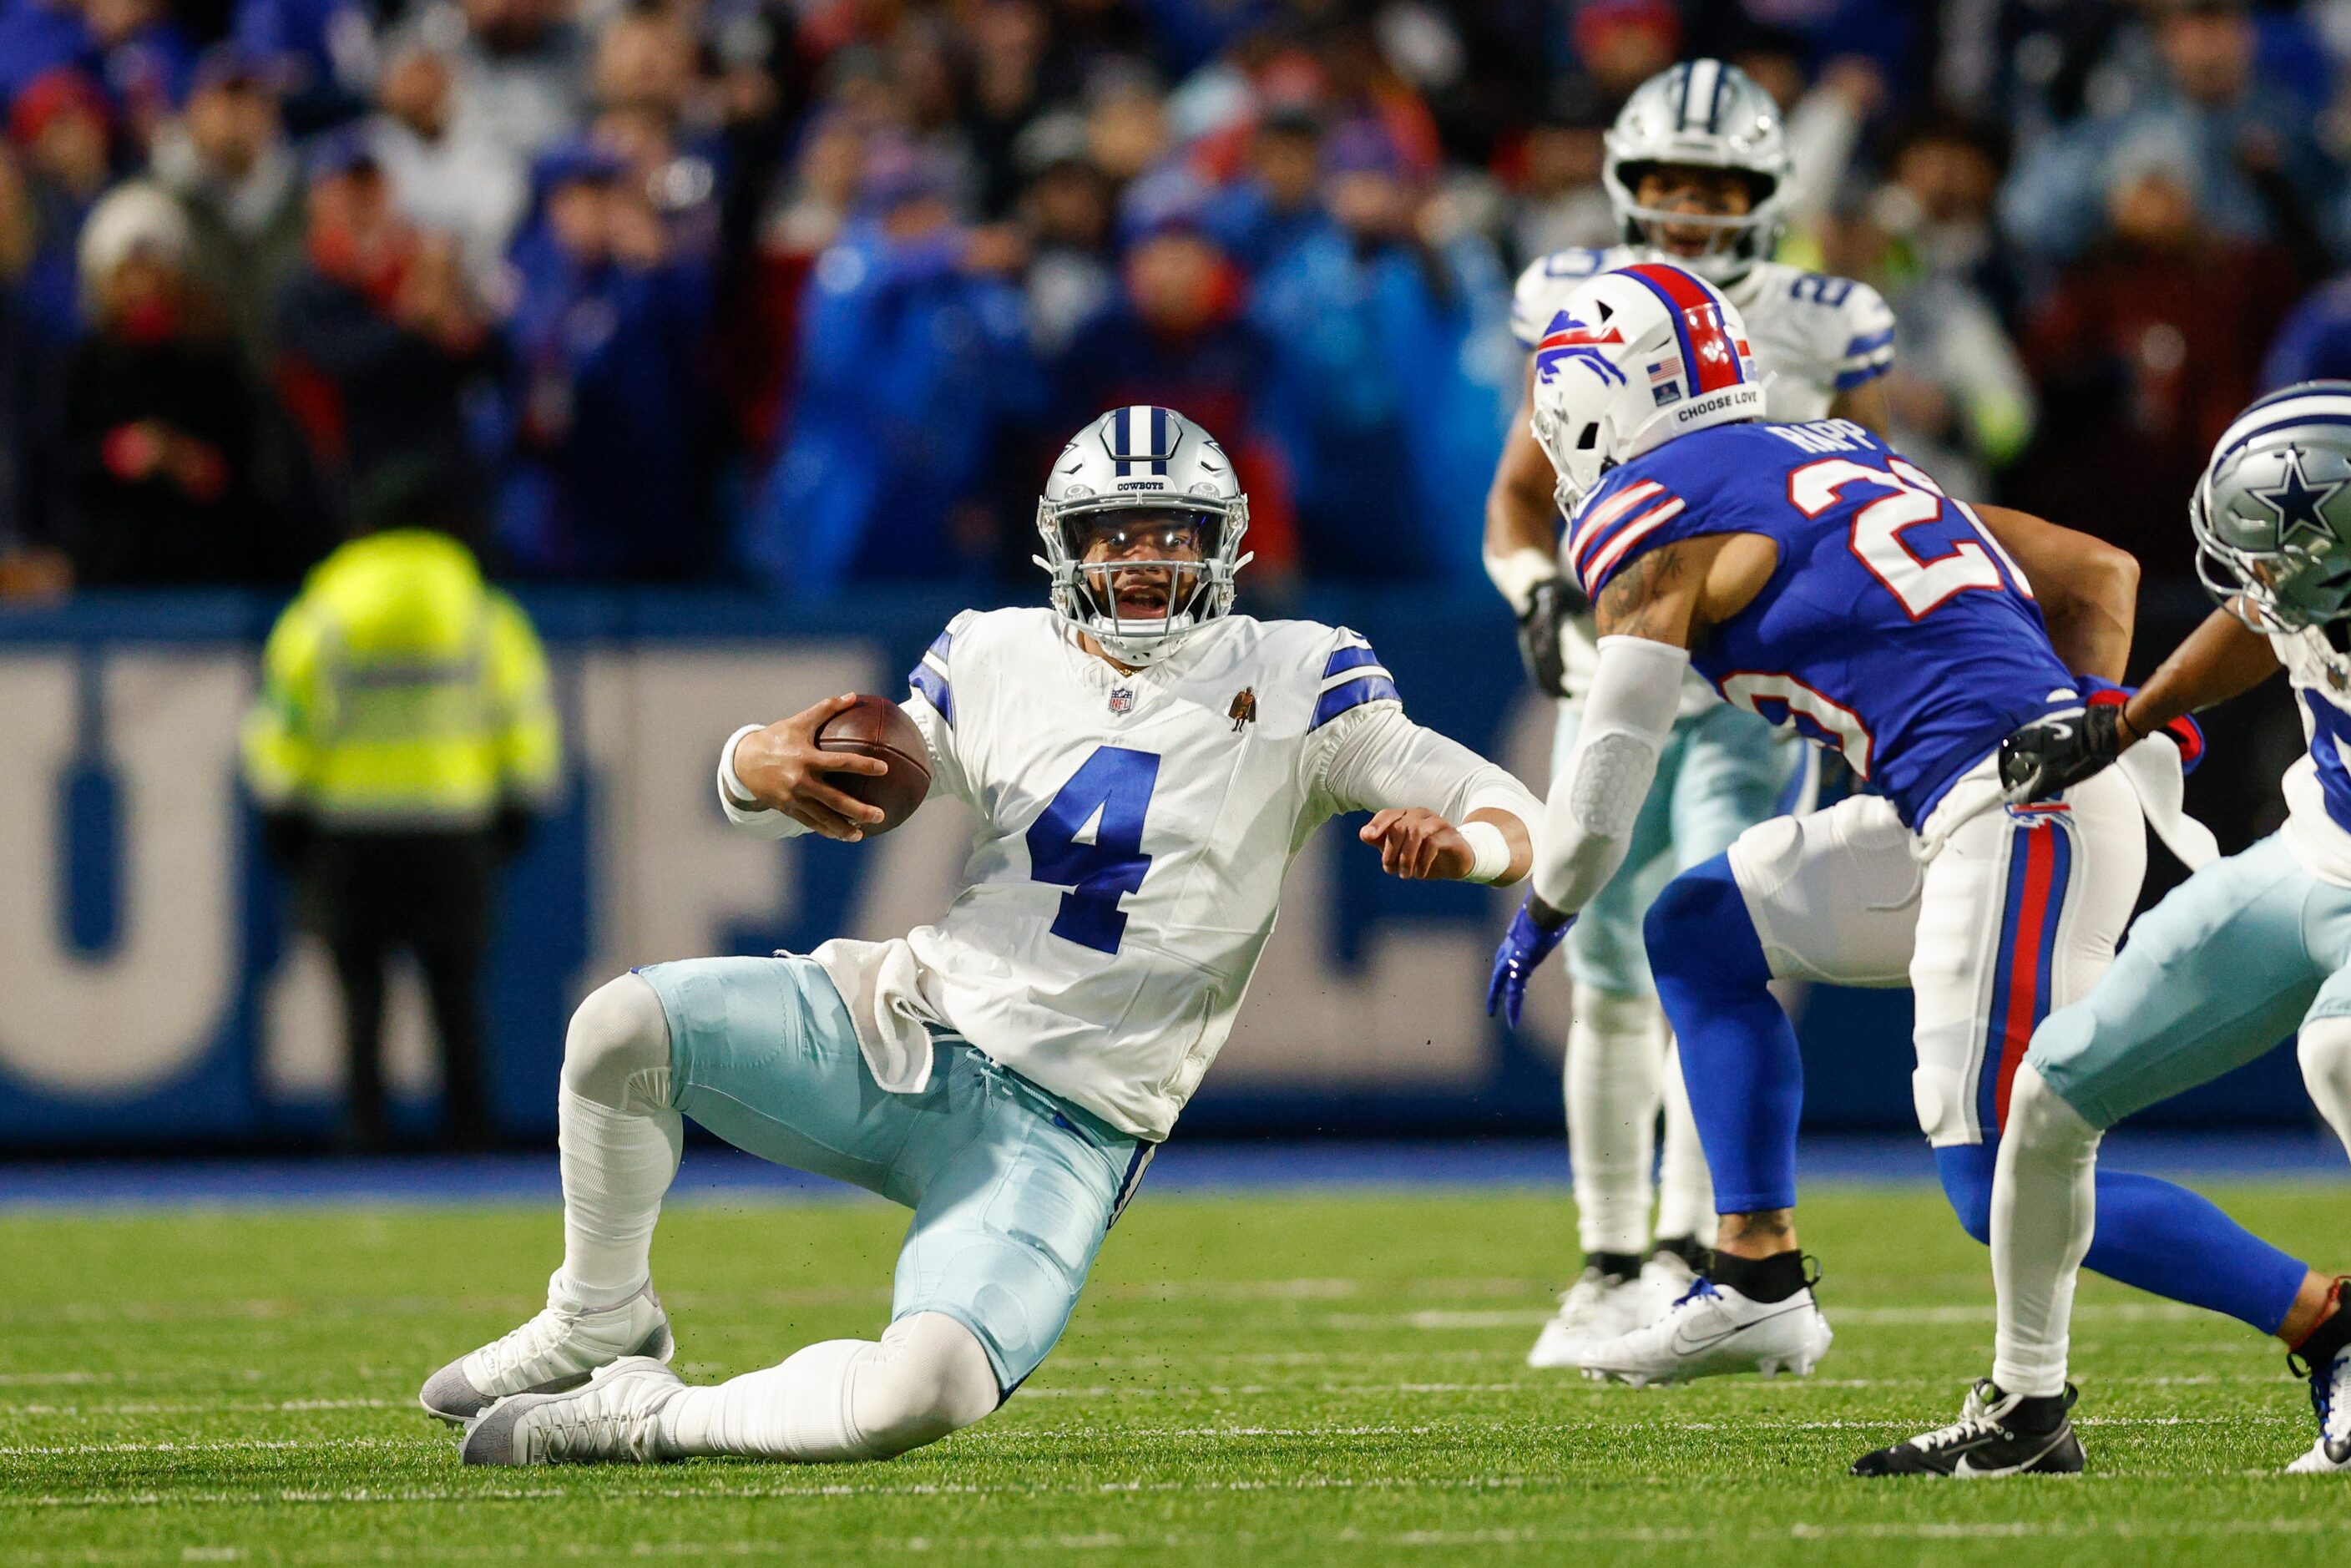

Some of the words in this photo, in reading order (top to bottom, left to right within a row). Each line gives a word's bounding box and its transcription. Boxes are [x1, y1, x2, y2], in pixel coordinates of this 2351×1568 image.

[1678, 395, 1732, 422] CHOOSE
[1734, 391, 1757, 404] LOVE
[1763, 418, 1878, 453] RAPP
[1117, 482, 1164, 492] COWBOYS
[1110, 697, 1131, 711] NFL
[1025, 745, 1161, 955] 4
